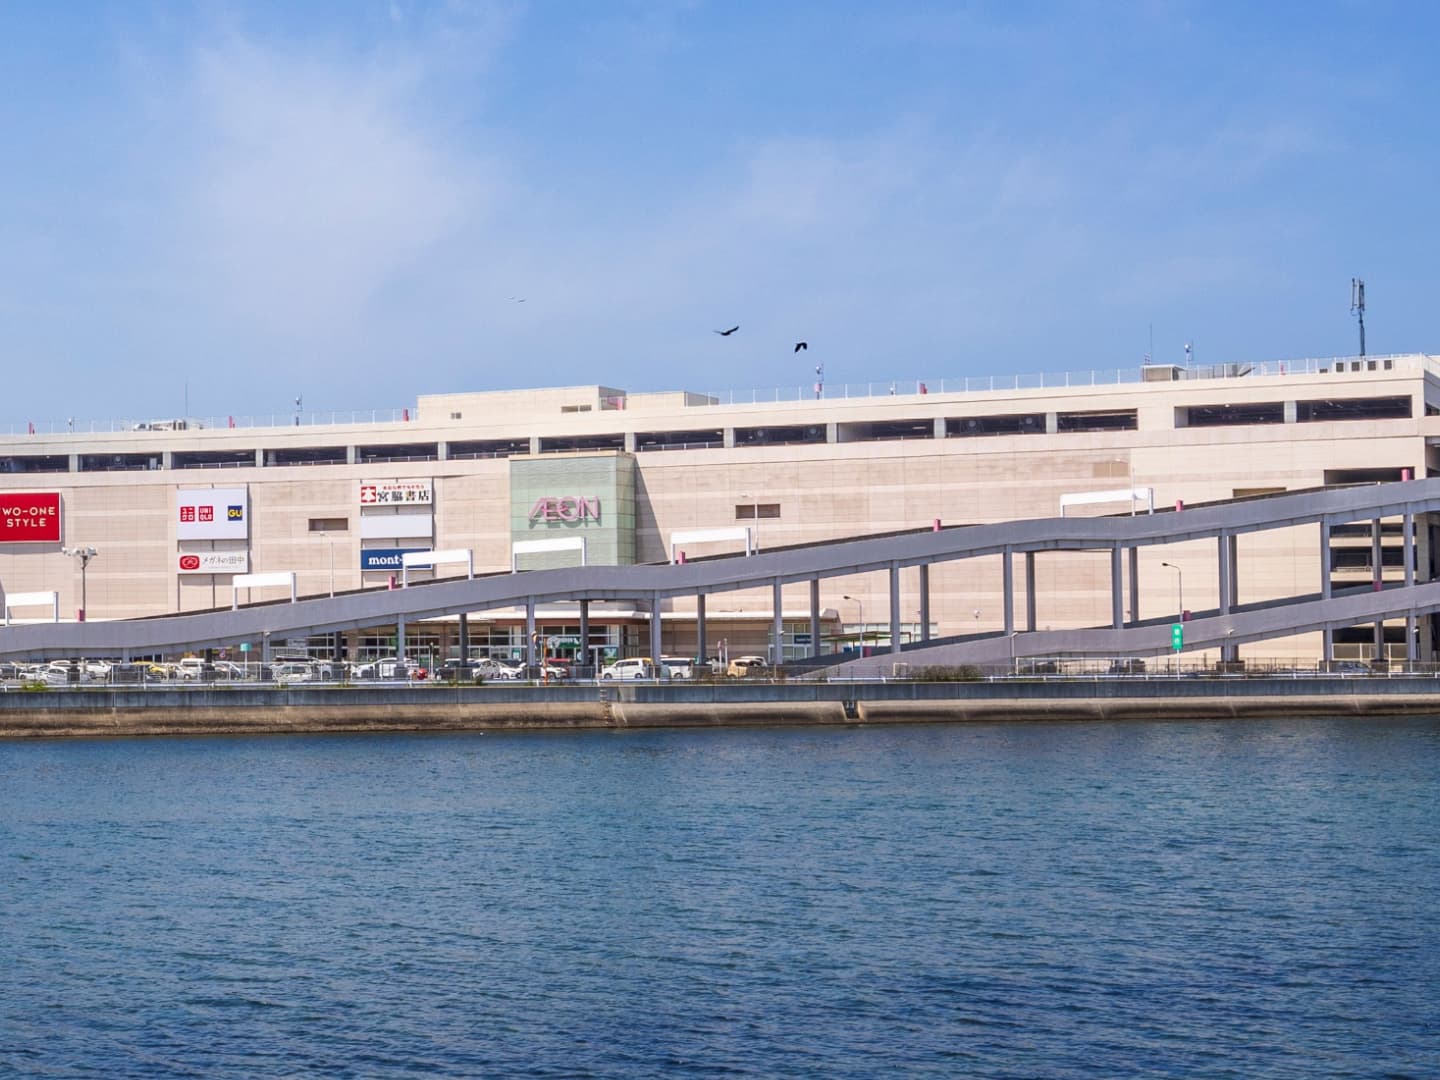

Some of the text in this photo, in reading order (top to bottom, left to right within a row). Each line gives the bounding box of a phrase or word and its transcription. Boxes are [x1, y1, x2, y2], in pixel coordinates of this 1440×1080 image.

[377, 490, 430, 502] 宮脇書店
[228, 509, 242, 517] GU
[6, 518, 47, 528] STYLE
[203, 556, 245, 564] メガネの田中
